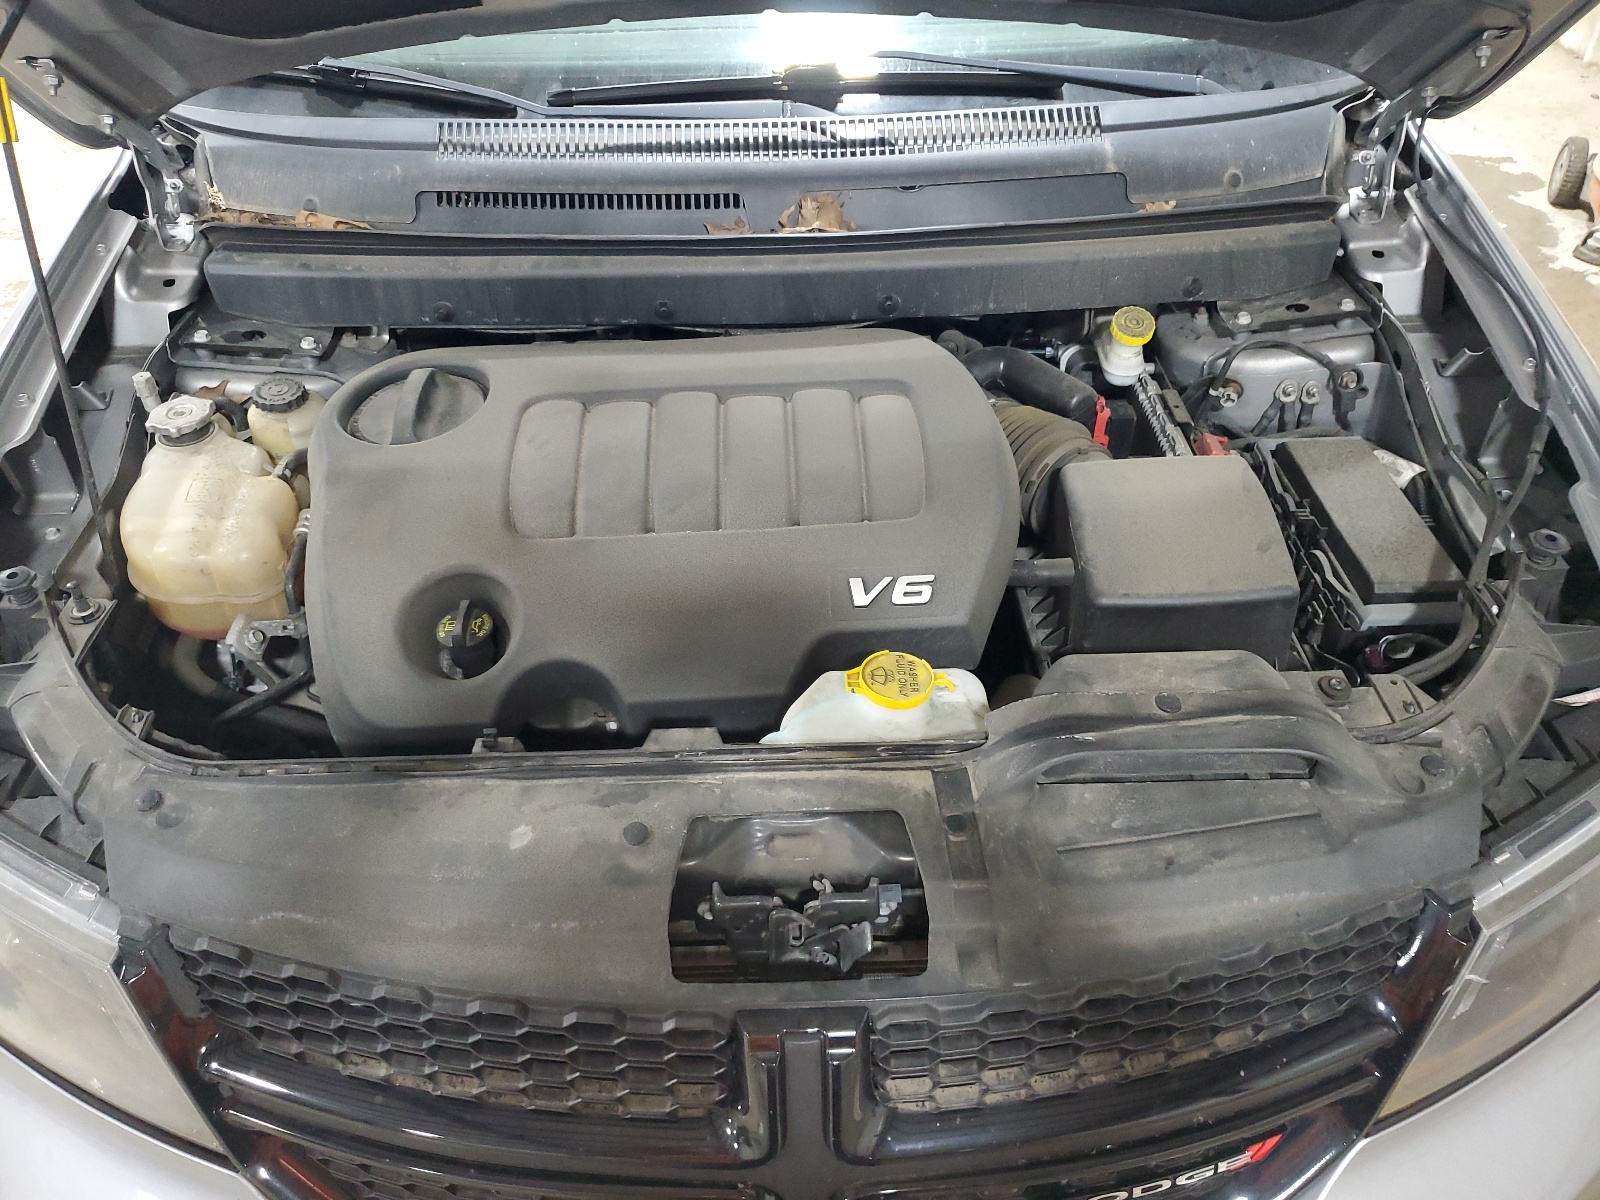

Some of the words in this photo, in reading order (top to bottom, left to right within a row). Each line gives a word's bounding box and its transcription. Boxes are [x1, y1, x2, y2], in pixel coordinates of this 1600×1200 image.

[848, 574, 936, 608] V6
[895, 654, 906, 677] FLUID
[907, 660, 919, 693] WASHER
[898, 677, 909, 698] ONLY
